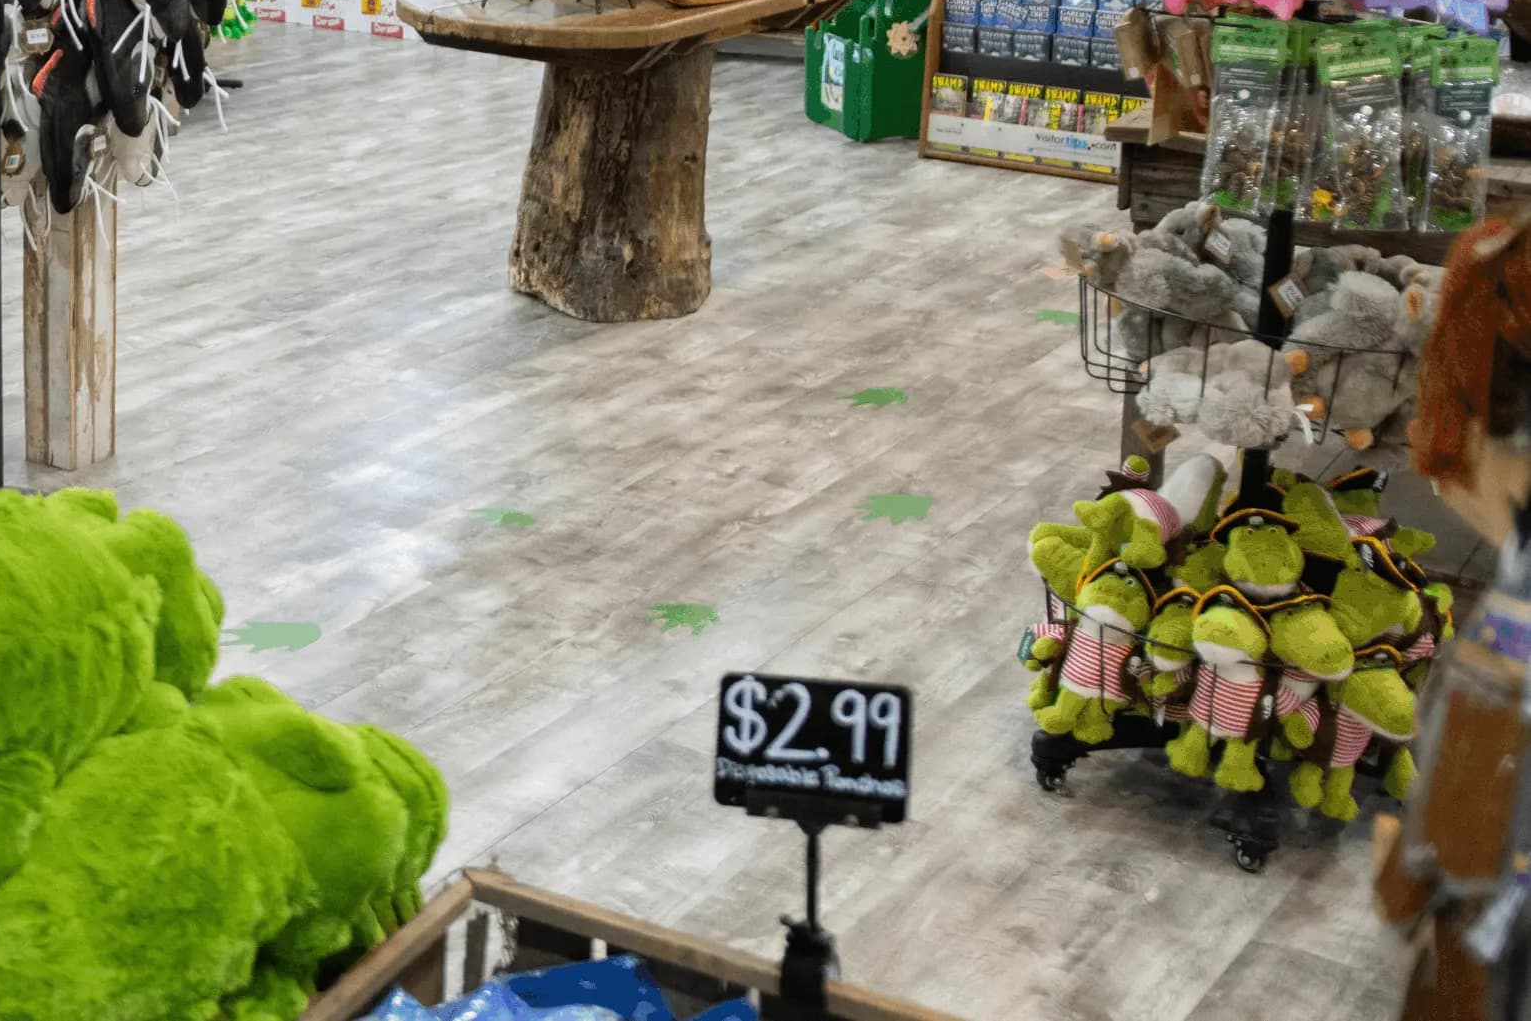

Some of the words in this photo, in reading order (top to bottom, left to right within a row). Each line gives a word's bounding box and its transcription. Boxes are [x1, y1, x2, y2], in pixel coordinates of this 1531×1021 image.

[933, 75, 964, 90] SWAMP
[974, 79, 1005, 94] SWAMP
[1009, 82, 1042, 98] SWAMP
[1045, 86, 1078, 103] SWAMP
[1085, 91, 1118, 107] SWAMP
[723, 675, 903, 770] $2.99
